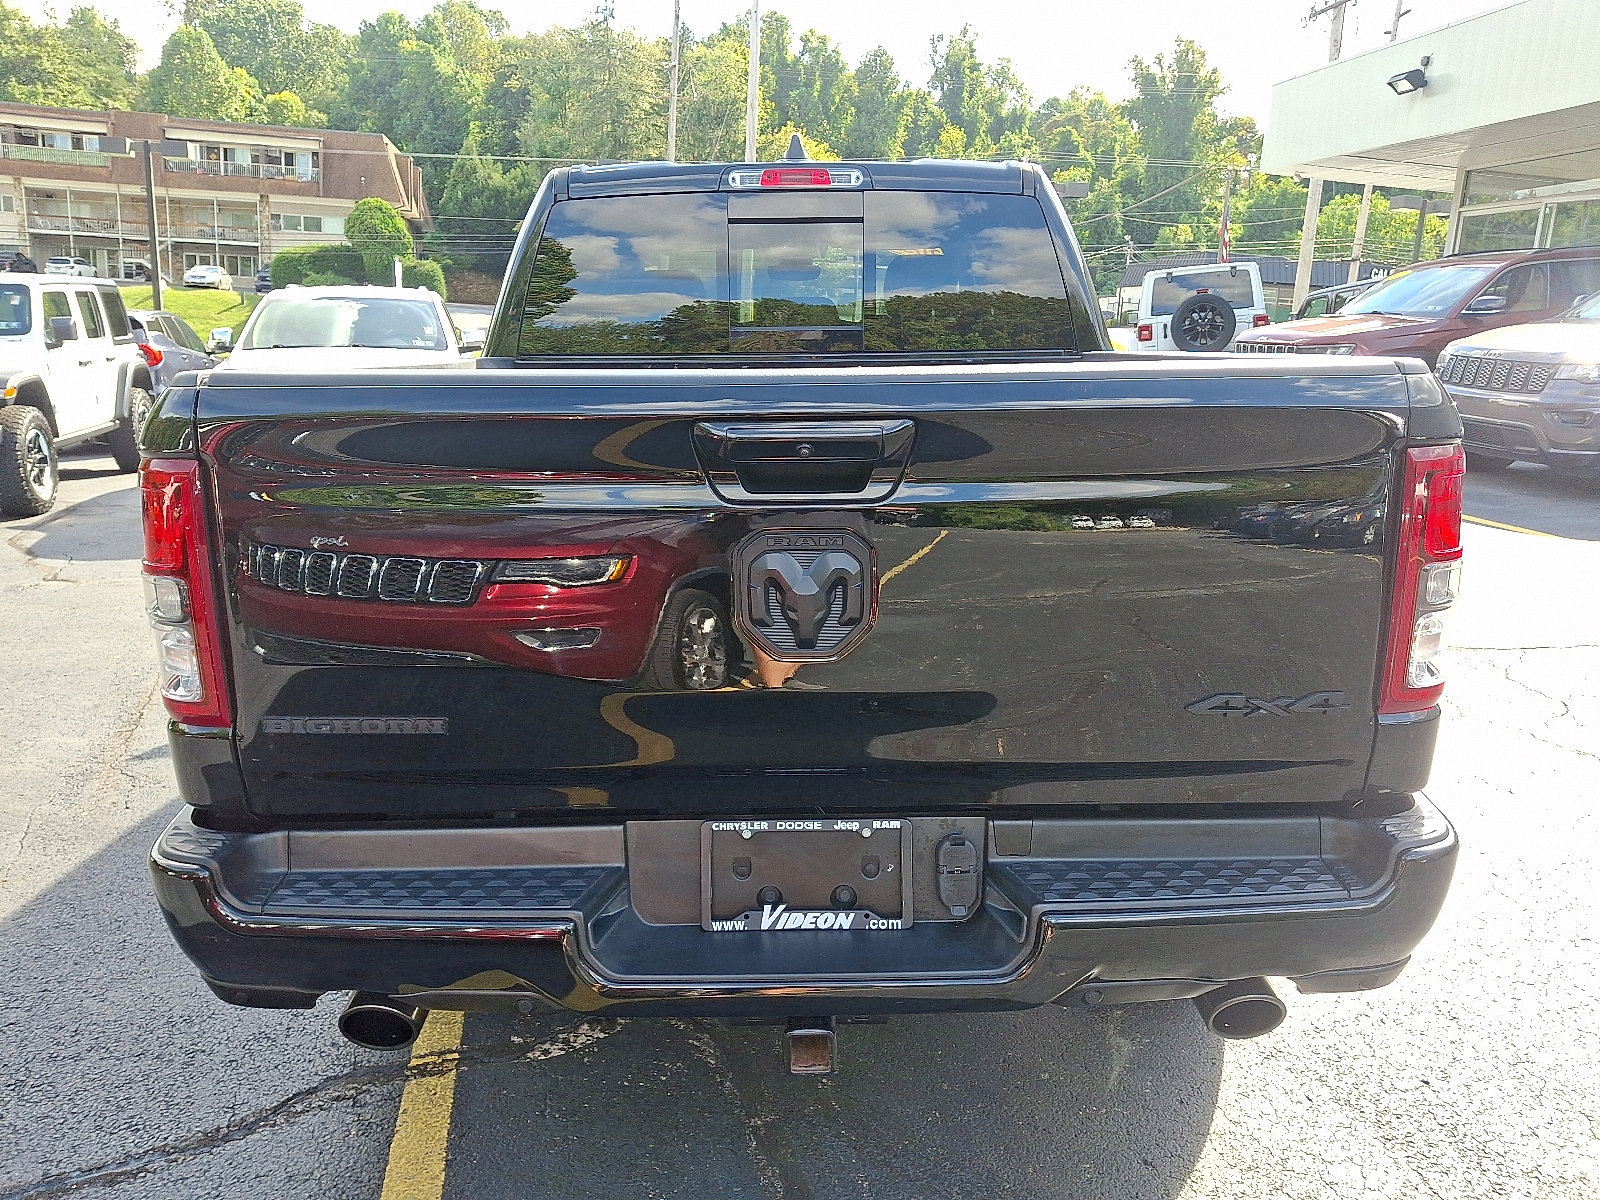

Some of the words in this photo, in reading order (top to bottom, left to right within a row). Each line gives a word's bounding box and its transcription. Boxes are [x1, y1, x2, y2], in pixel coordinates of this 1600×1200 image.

[766, 536, 844, 547] RAM
[711, 821, 769, 831] CHRYSLER
[776, 821, 823, 830] DODGE
[833, 820, 860, 832] Jeep
[872, 820, 901, 829] RAM
